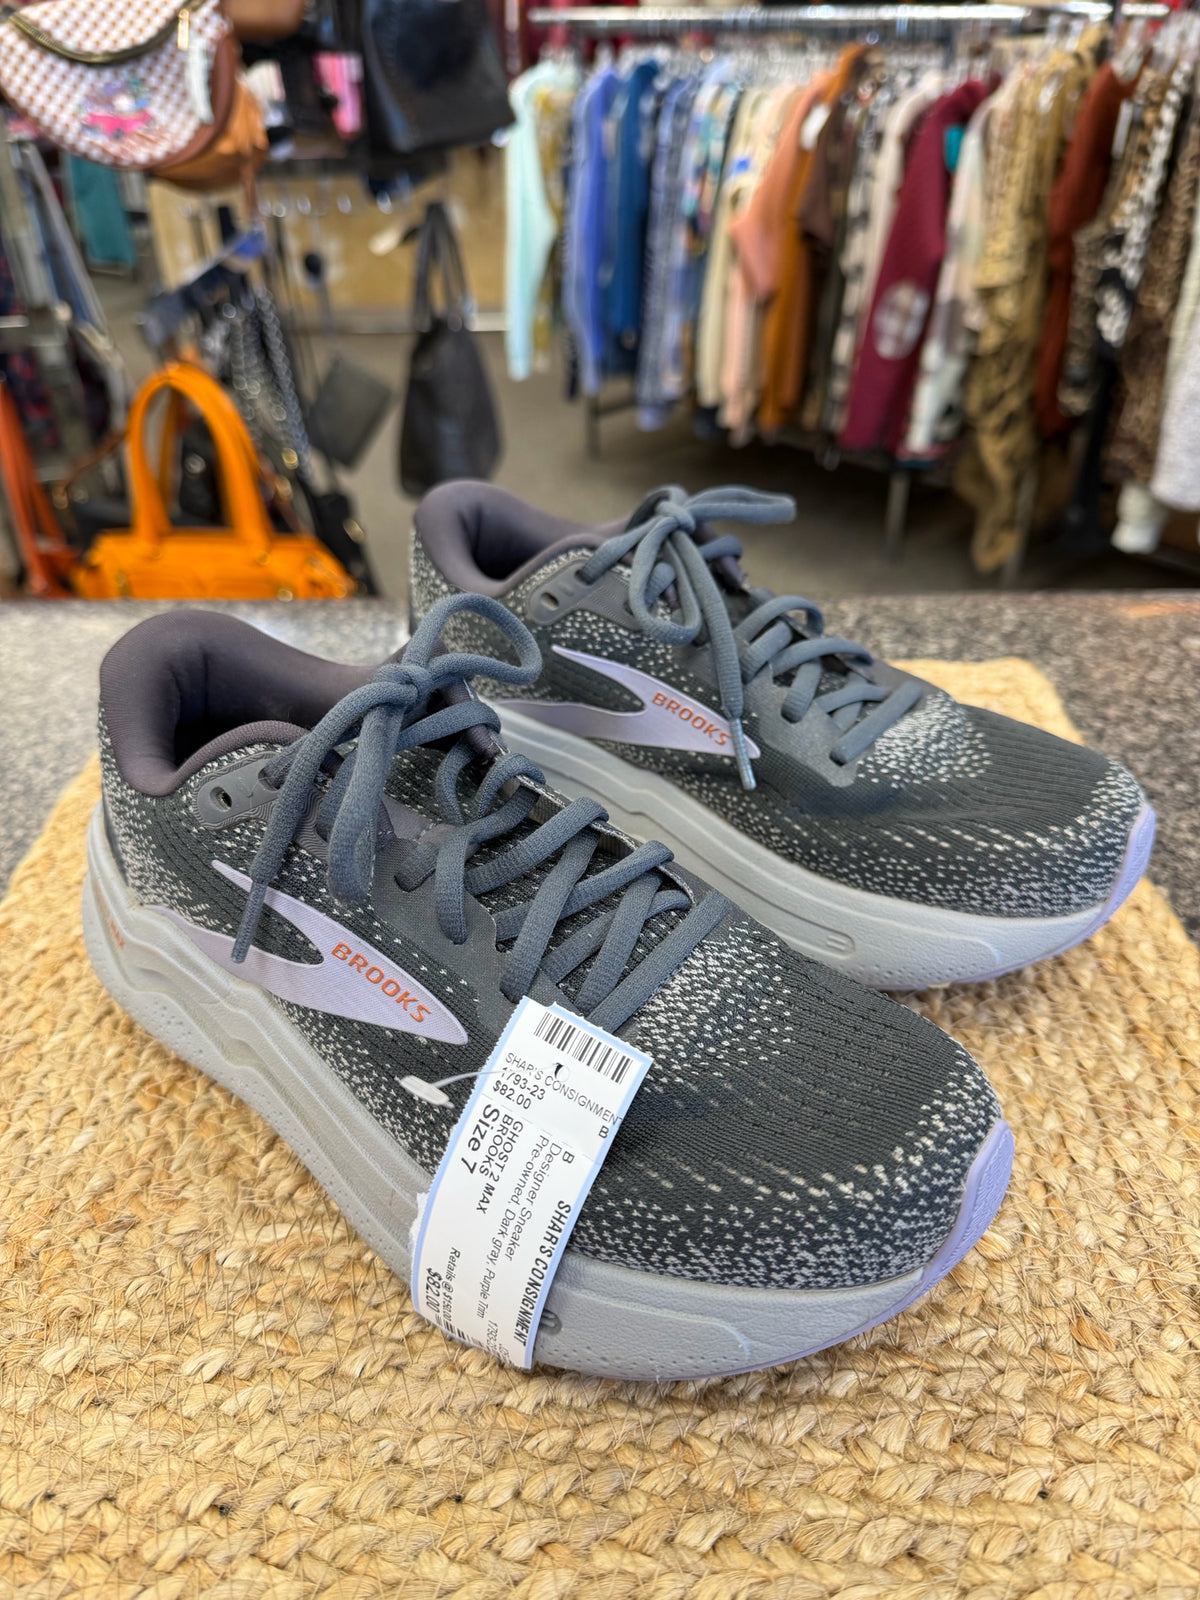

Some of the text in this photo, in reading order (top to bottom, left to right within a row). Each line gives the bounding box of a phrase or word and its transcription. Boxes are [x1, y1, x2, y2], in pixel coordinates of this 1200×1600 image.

[652, 692, 732, 746] BROOKS
[331, 942, 432, 1023] BROOKS
[501, 1067, 546, 1101] 1793-23
[505, 1052, 543, 1080] SHAR'S
[493, 1079, 532, 1110] $82.00
[461, 1103, 500, 1174] Size 7
[479, 1113, 514, 1177] BROOKS
[562, 1150, 575, 1164] B
[598, 1125, 610, 1139] B
[476, 1120, 524, 1214] GHOST 2 MAX
[476, 1134, 550, 1319] Pre-owned, Dark gray, Purple Trim
[504, 1142, 562, 1262] Designer Sneaker
[441, 1281, 454, 1294] @
[445, 1246, 460, 1282] Retails
[513, 1200, 571, 1347] SHAR'S CONSIGNMENT
[426, 1267, 443, 1313] $82.00
